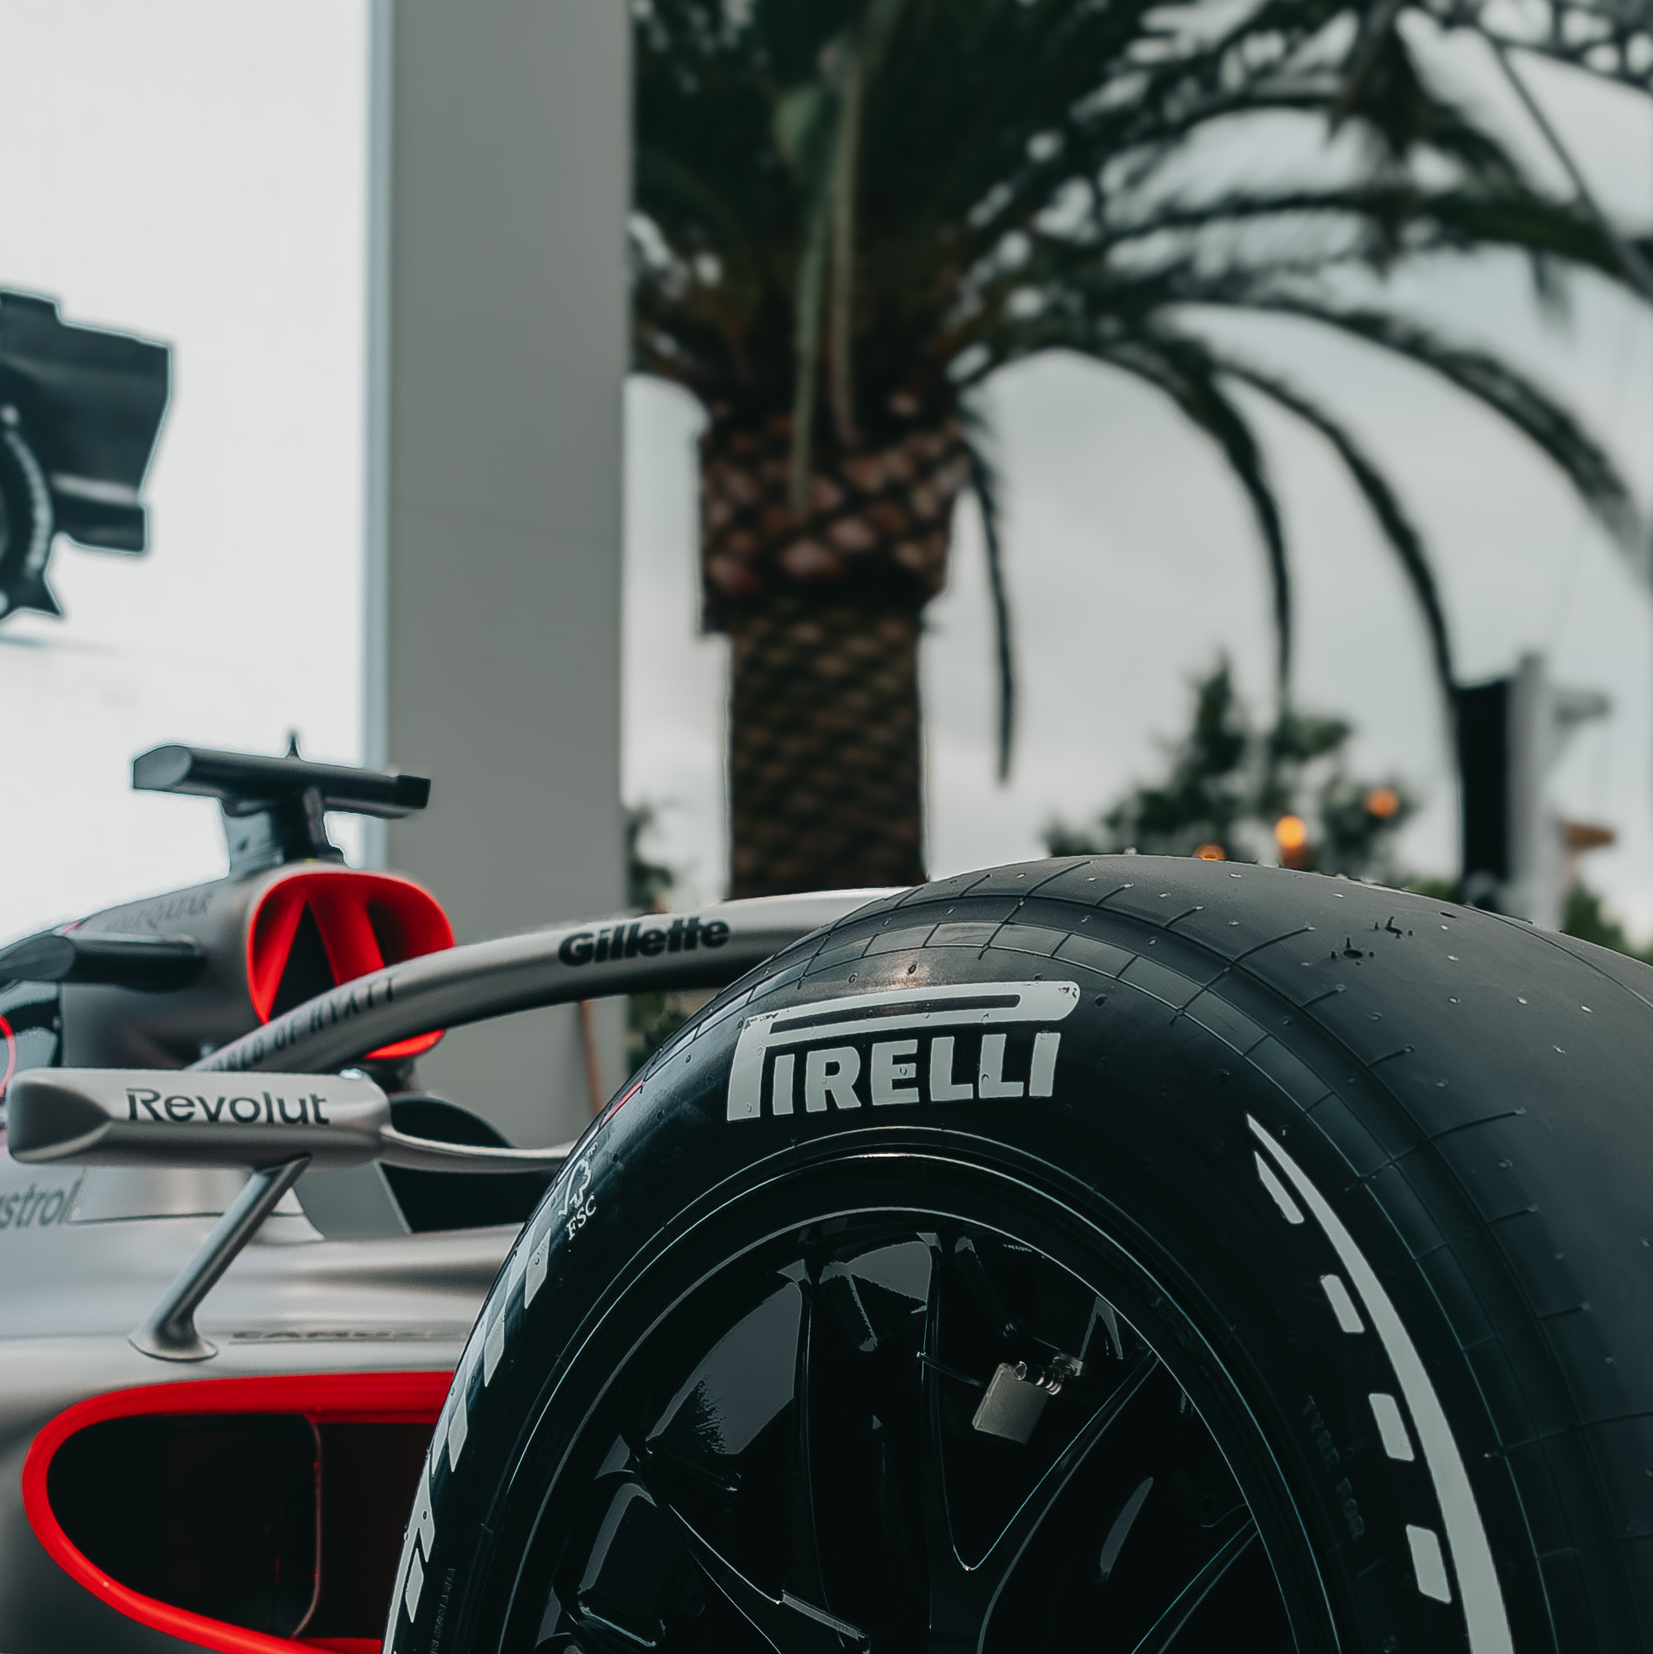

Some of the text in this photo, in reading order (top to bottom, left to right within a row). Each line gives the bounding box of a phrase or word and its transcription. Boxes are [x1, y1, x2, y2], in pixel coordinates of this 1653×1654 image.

[558, 916, 730, 967] Gillette
[726, 980, 1081, 1121] PIRELLI
[126, 1087, 333, 1125] Revolut
[565, 1193, 597, 1241] FSC
